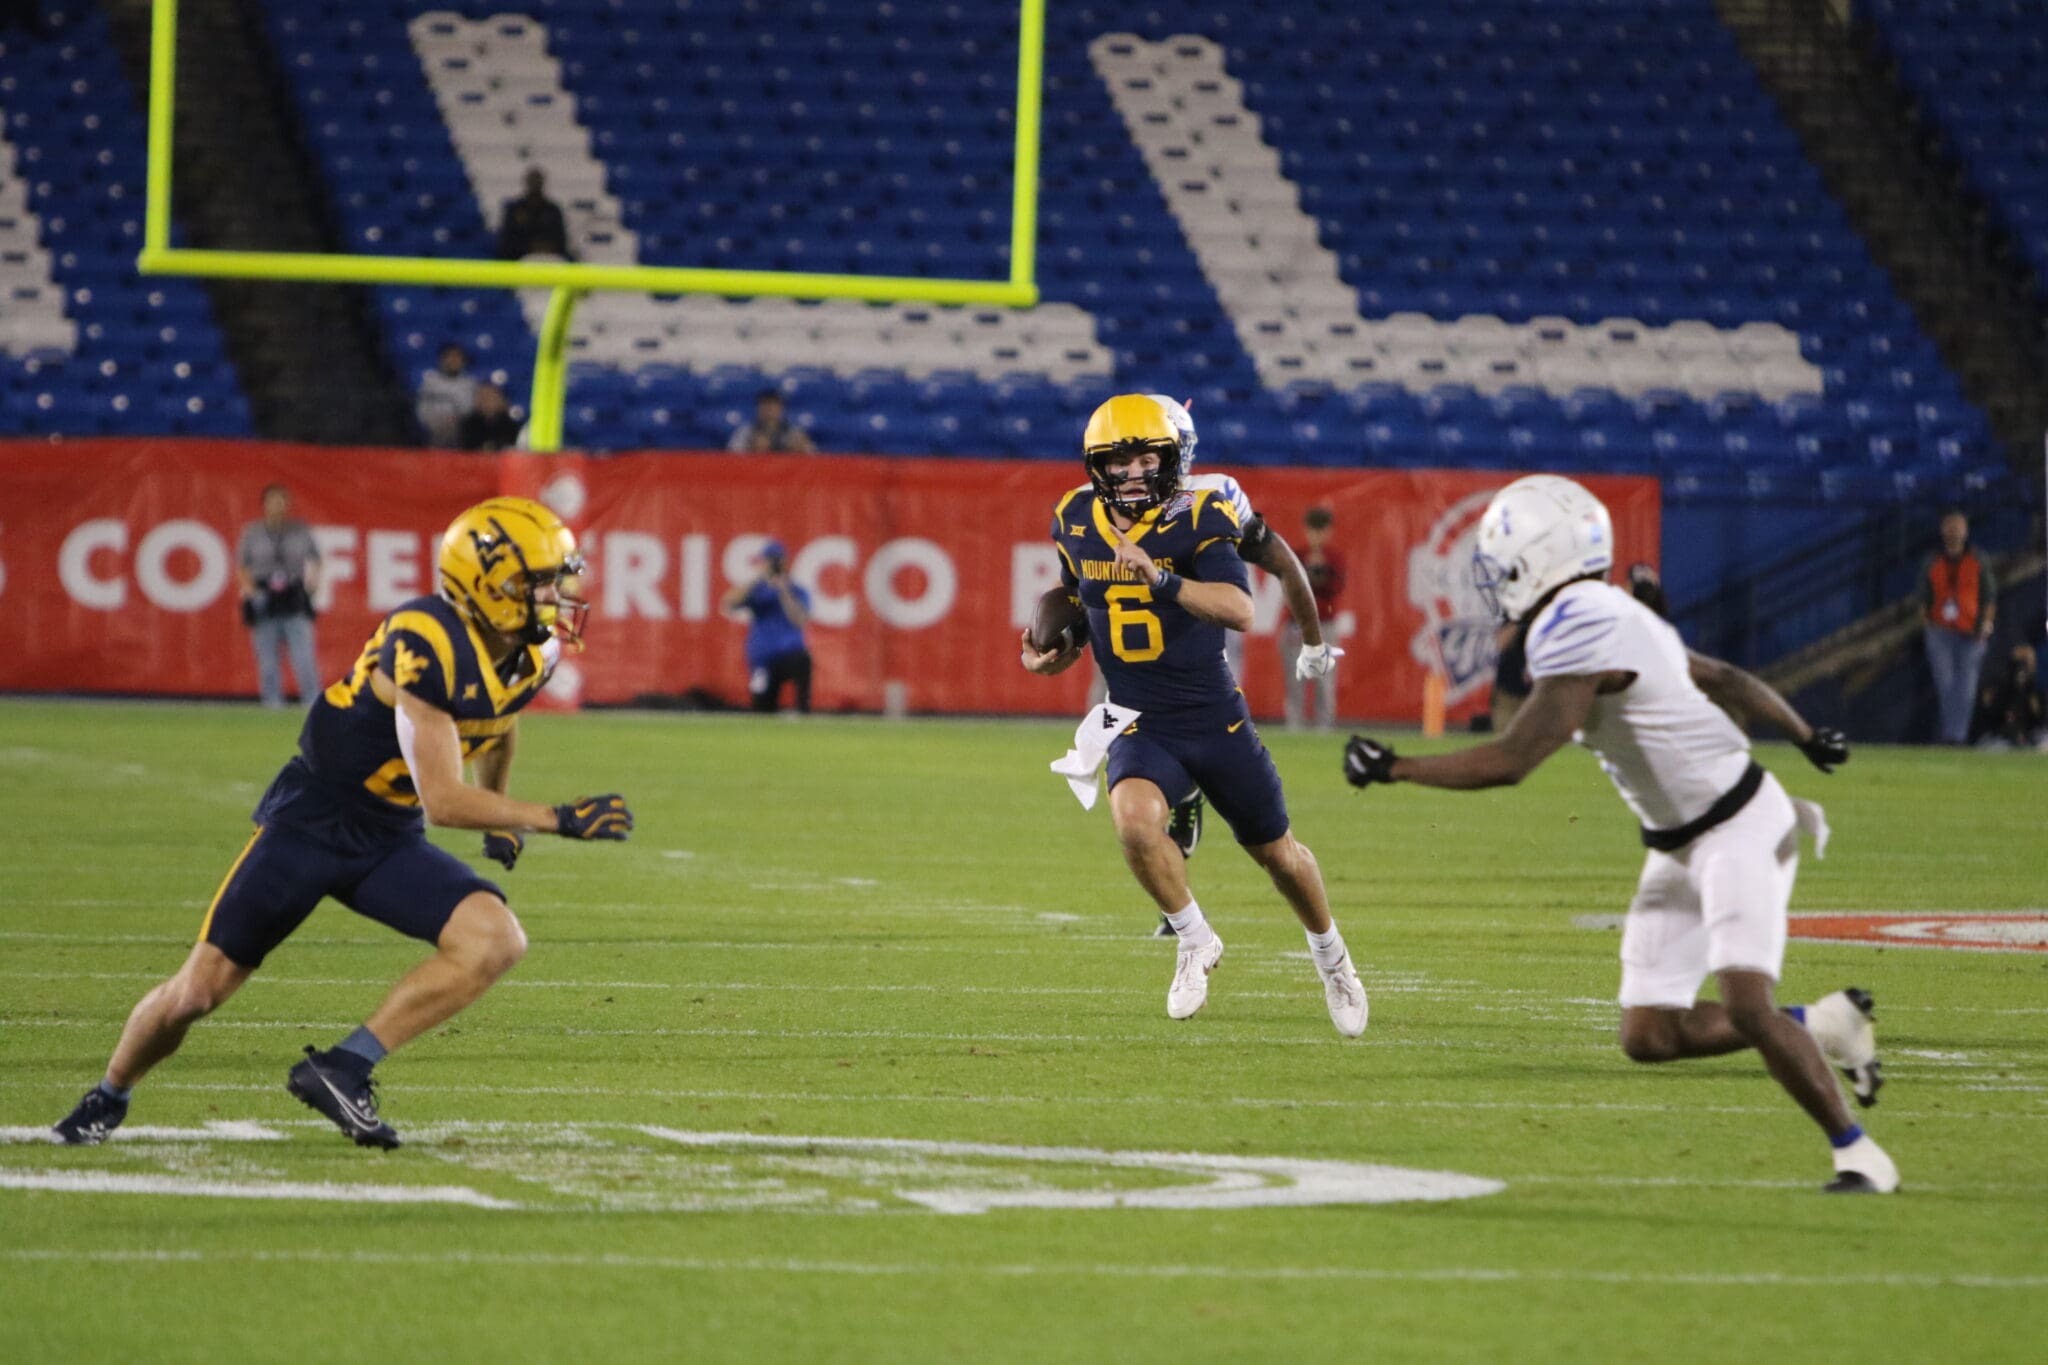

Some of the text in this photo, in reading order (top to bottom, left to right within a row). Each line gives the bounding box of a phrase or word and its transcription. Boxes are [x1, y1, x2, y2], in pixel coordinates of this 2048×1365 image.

[57, 517, 442, 614] COFE
[578, 529, 958, 629] RISCO
[1103, 584, 1165, 663] 6
